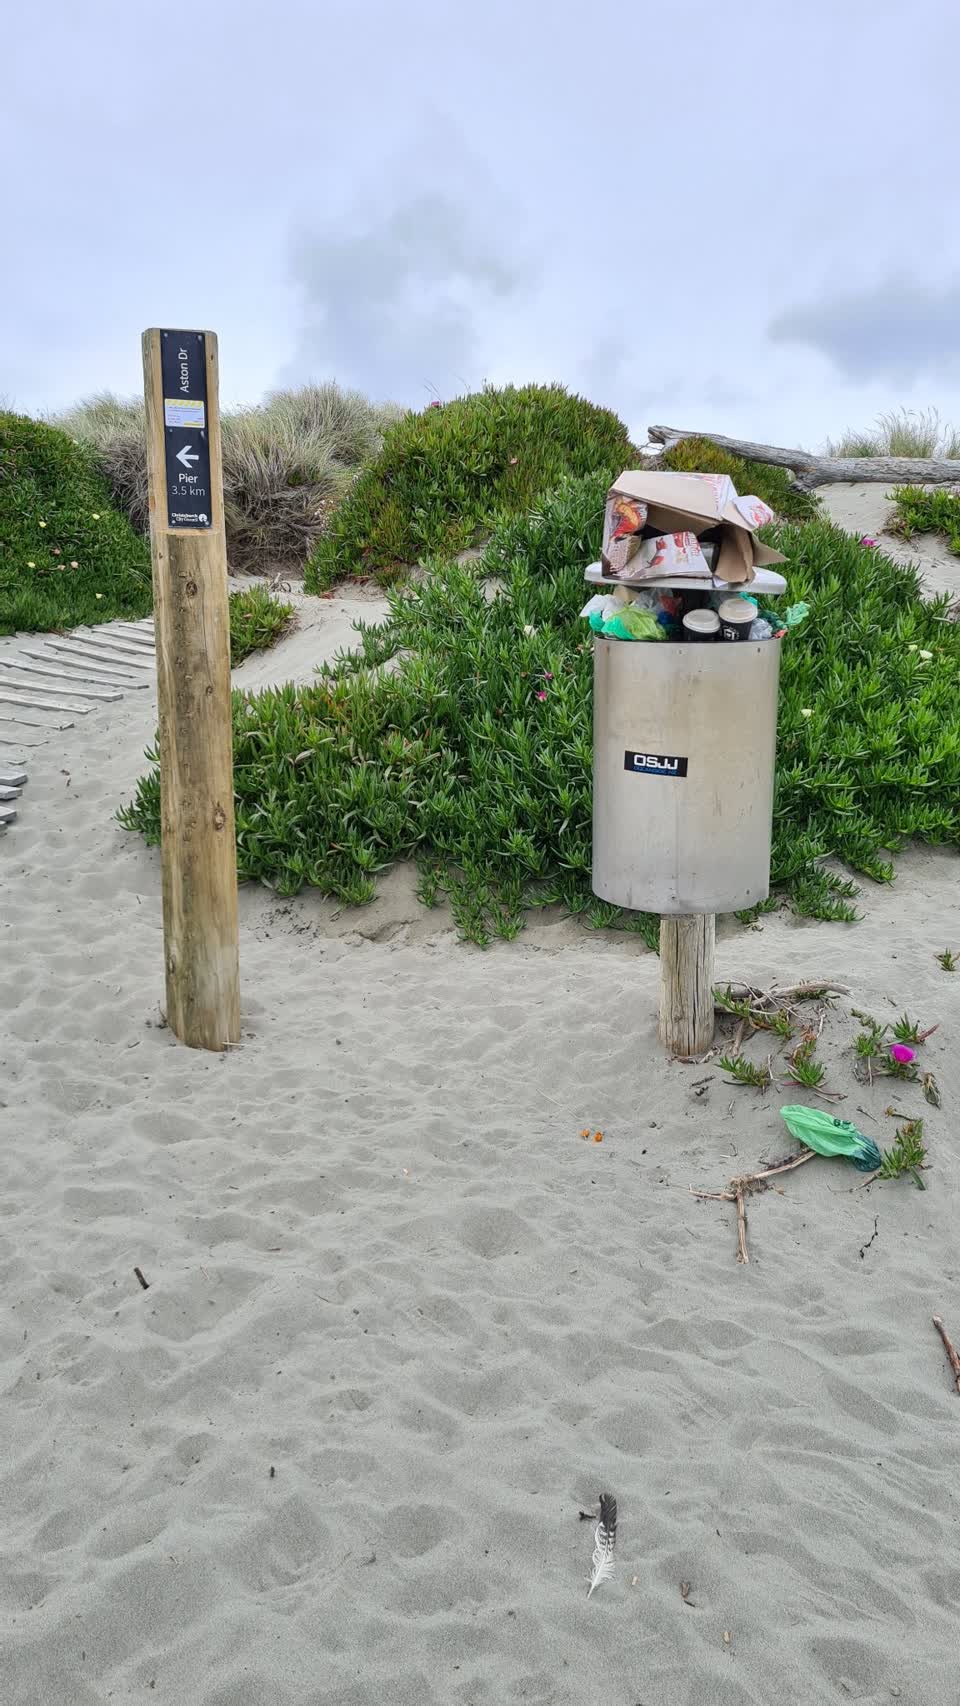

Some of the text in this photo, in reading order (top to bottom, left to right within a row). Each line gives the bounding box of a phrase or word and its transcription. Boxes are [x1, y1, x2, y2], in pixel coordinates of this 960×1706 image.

[178, 347, 190, 393] Aston Dr
[178, 473, 198, 484] Pier
[171, 485, 206, 496] 3.5 km
[634, 754, 678, 770] OSJJ
